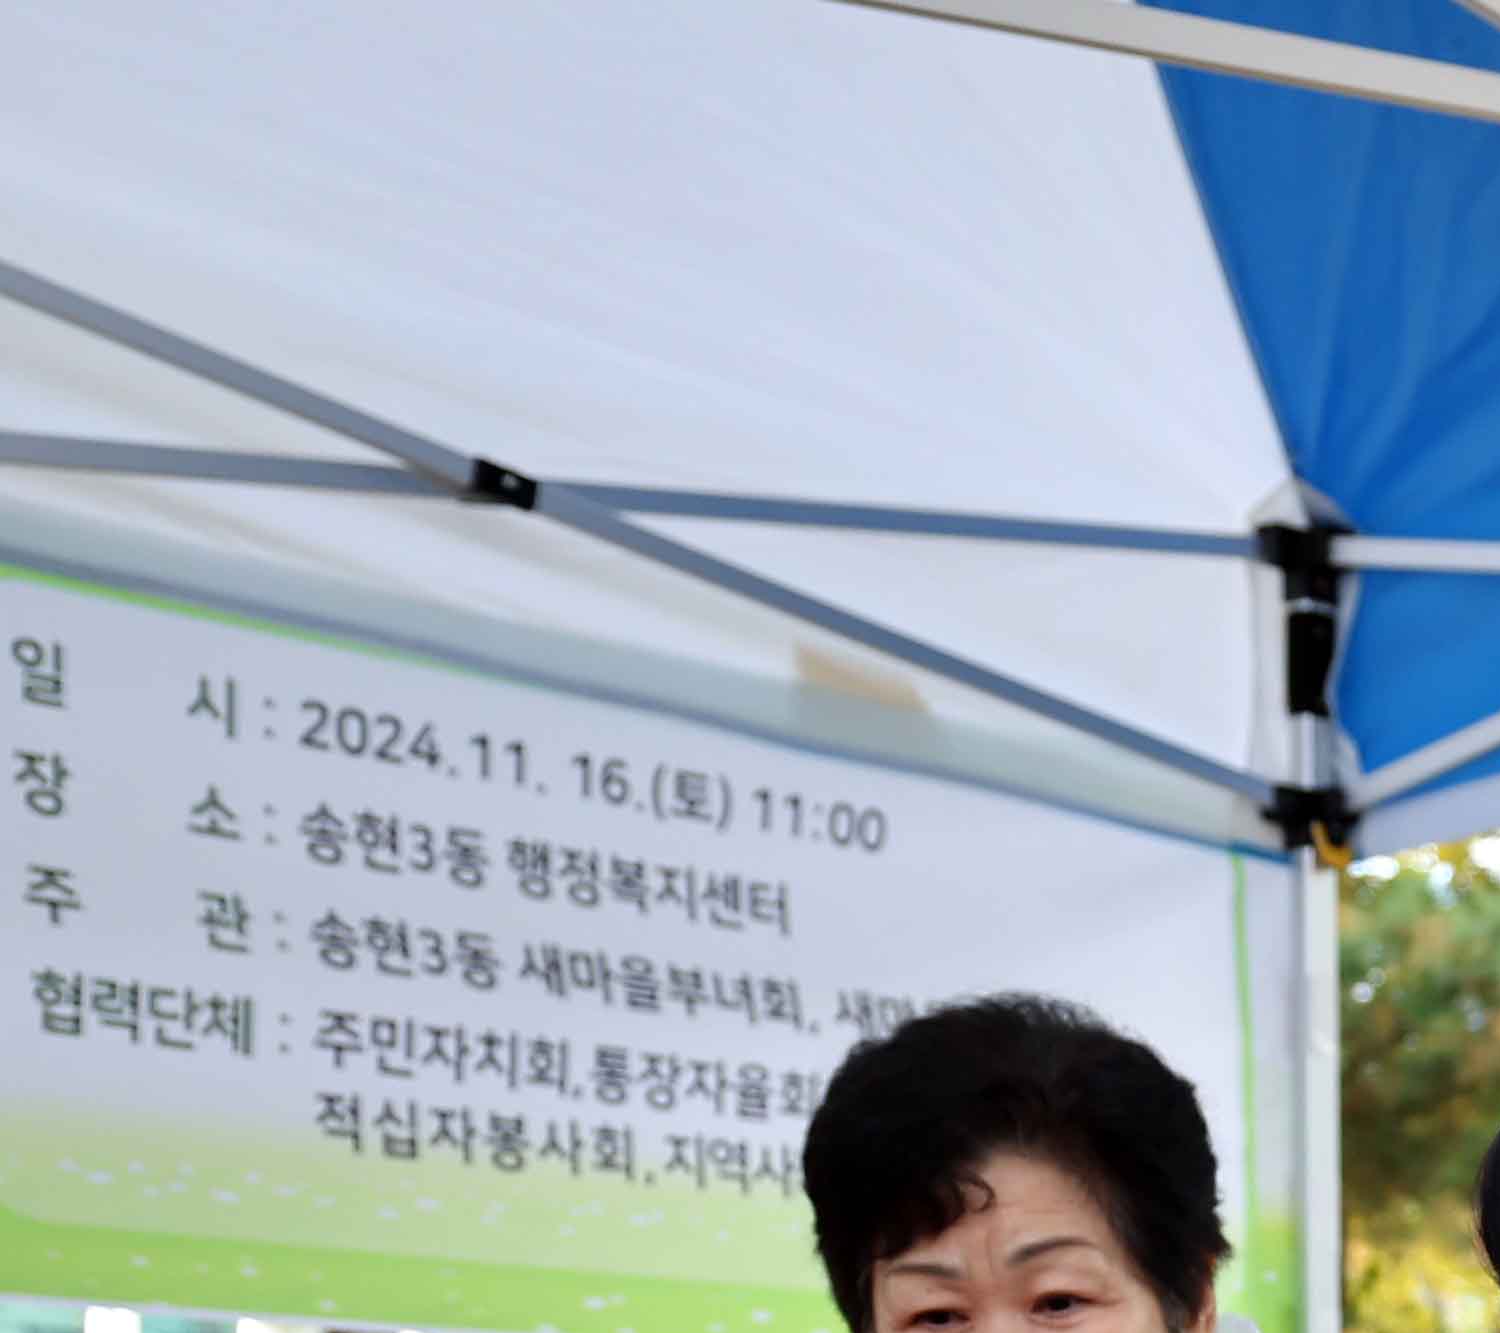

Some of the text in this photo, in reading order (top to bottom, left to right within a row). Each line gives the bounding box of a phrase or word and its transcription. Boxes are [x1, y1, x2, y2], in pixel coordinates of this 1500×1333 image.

[12, 636, 67, 711] 일
[186, 675, 239, 740] 시
[570, 752, 735, 831] 16.(토)
[752, 786, 887, 854] 11:00
[13, 749, 70, 819] 장
[187, 785, 242, 843] 소
[299, 800, 490, 890] 송현3동
[505, 835, 793, 936] 행정복지센터
[22, 863, 83, 927] 주
[197, 888, 254, 957] 관
[310, 907, 502, 993] 송현3동
[519, 941, 822, 1036] 새마을부녀회,
[30, 965, 256, 1058] 협력단체
[664, 1130, 806, 1198] 지역사
